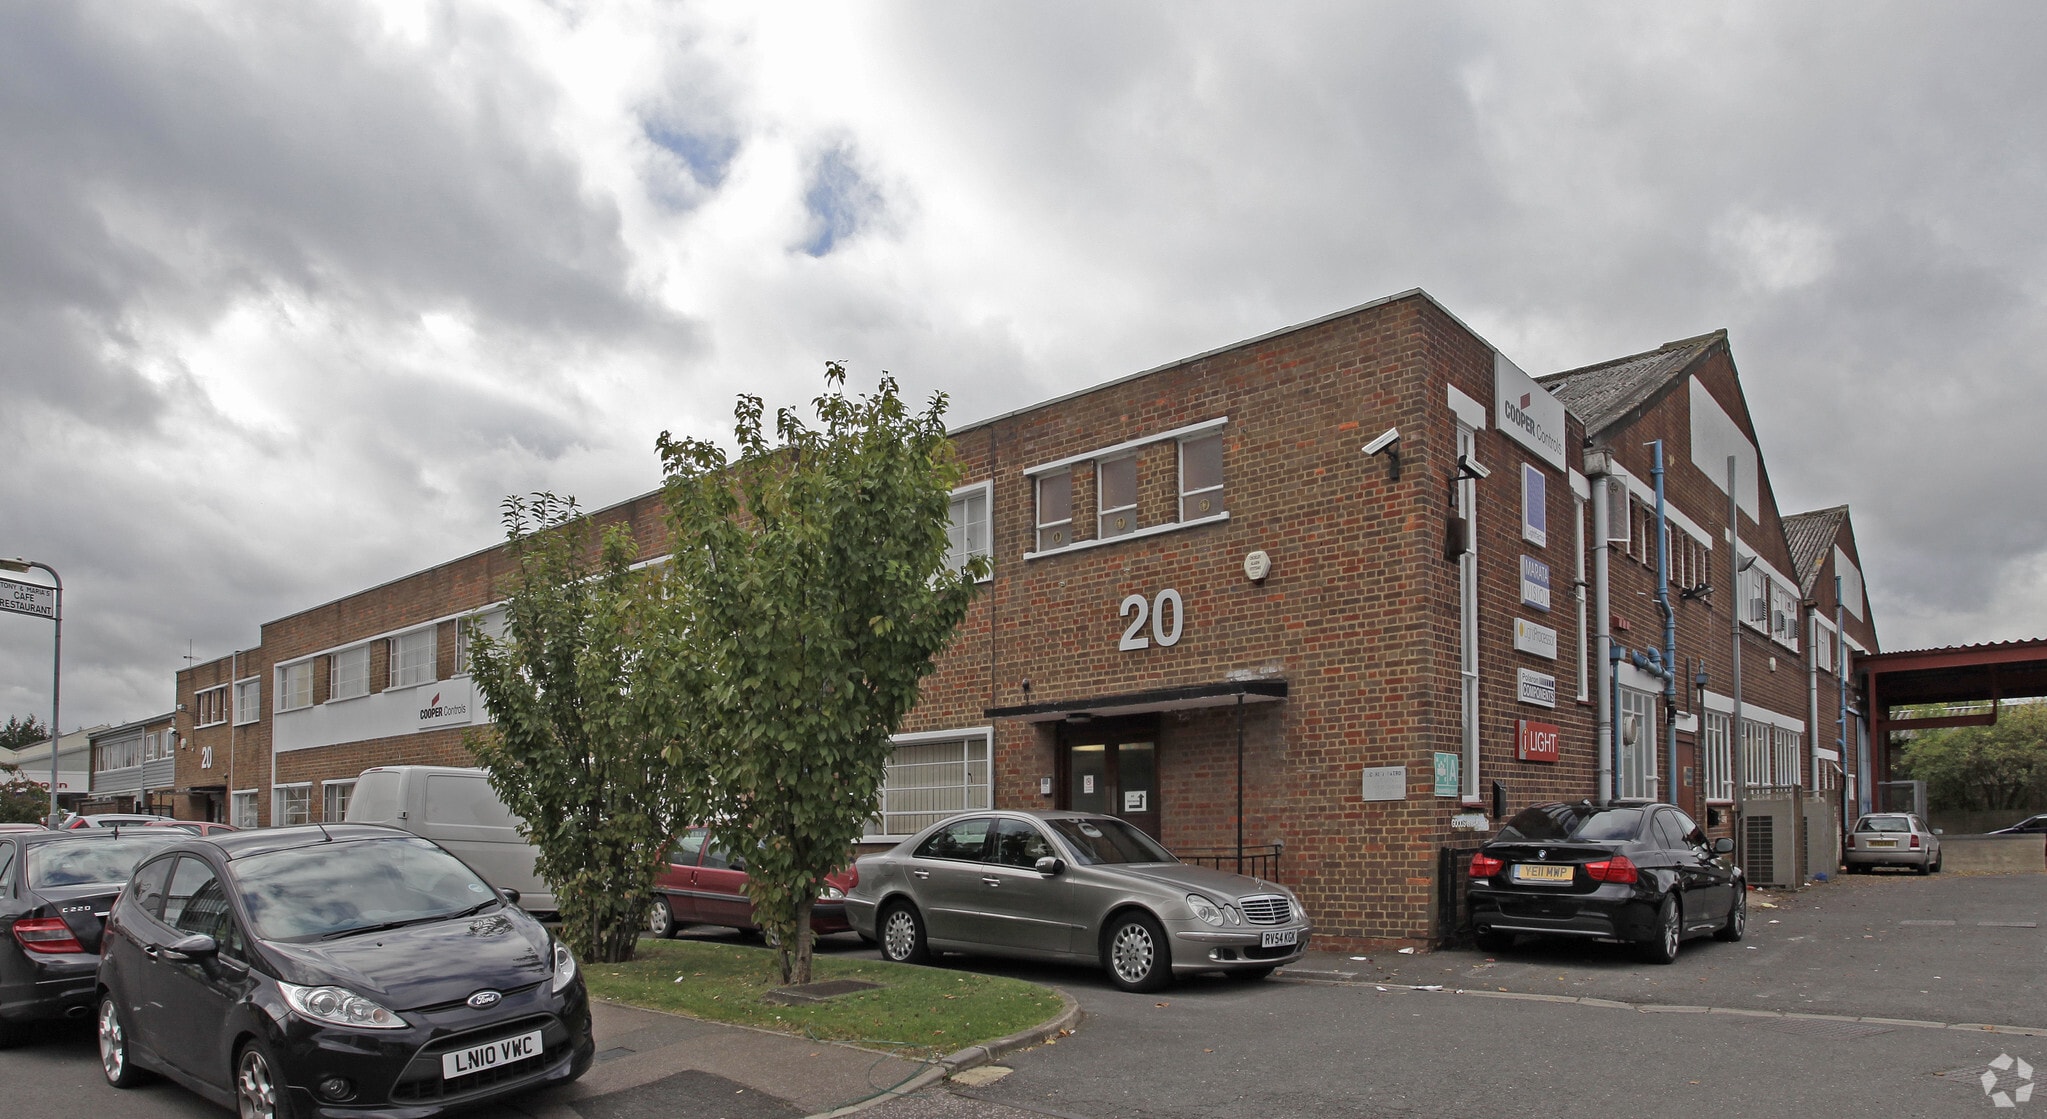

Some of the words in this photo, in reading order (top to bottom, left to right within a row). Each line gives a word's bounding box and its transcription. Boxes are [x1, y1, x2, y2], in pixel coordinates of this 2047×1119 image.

[1505, 400, 1535, 437] COOPER
[1537, 424, 1562, 455] Controls
[1525, 559, 1549, 584] MARATA
[13, 591, 35, 602] CAFE
[1526, 583, 1550, 606] VISION
[0, 598, 51, 615] RESTAURANT
[1119, 588, 1183, 651] 20
[1523, 684, 1555, 703] COMPONENTS
[420, 707, 443, 720] COOPER
[444, 704, 467, 716] Controls
[1530, 731, 1557, 753] LIGHT
[201, 746, 213, 769] 20
[1449, 760, 1457, 782] A
[1546, 867, 1567, 877] MWP
[1265, 932, 1283, 945] RV54
[475, 993, 496, 1005] Ford
[456, 1046, 496, 1072] LN10
[501, 1036, 533, 1060] VWC
